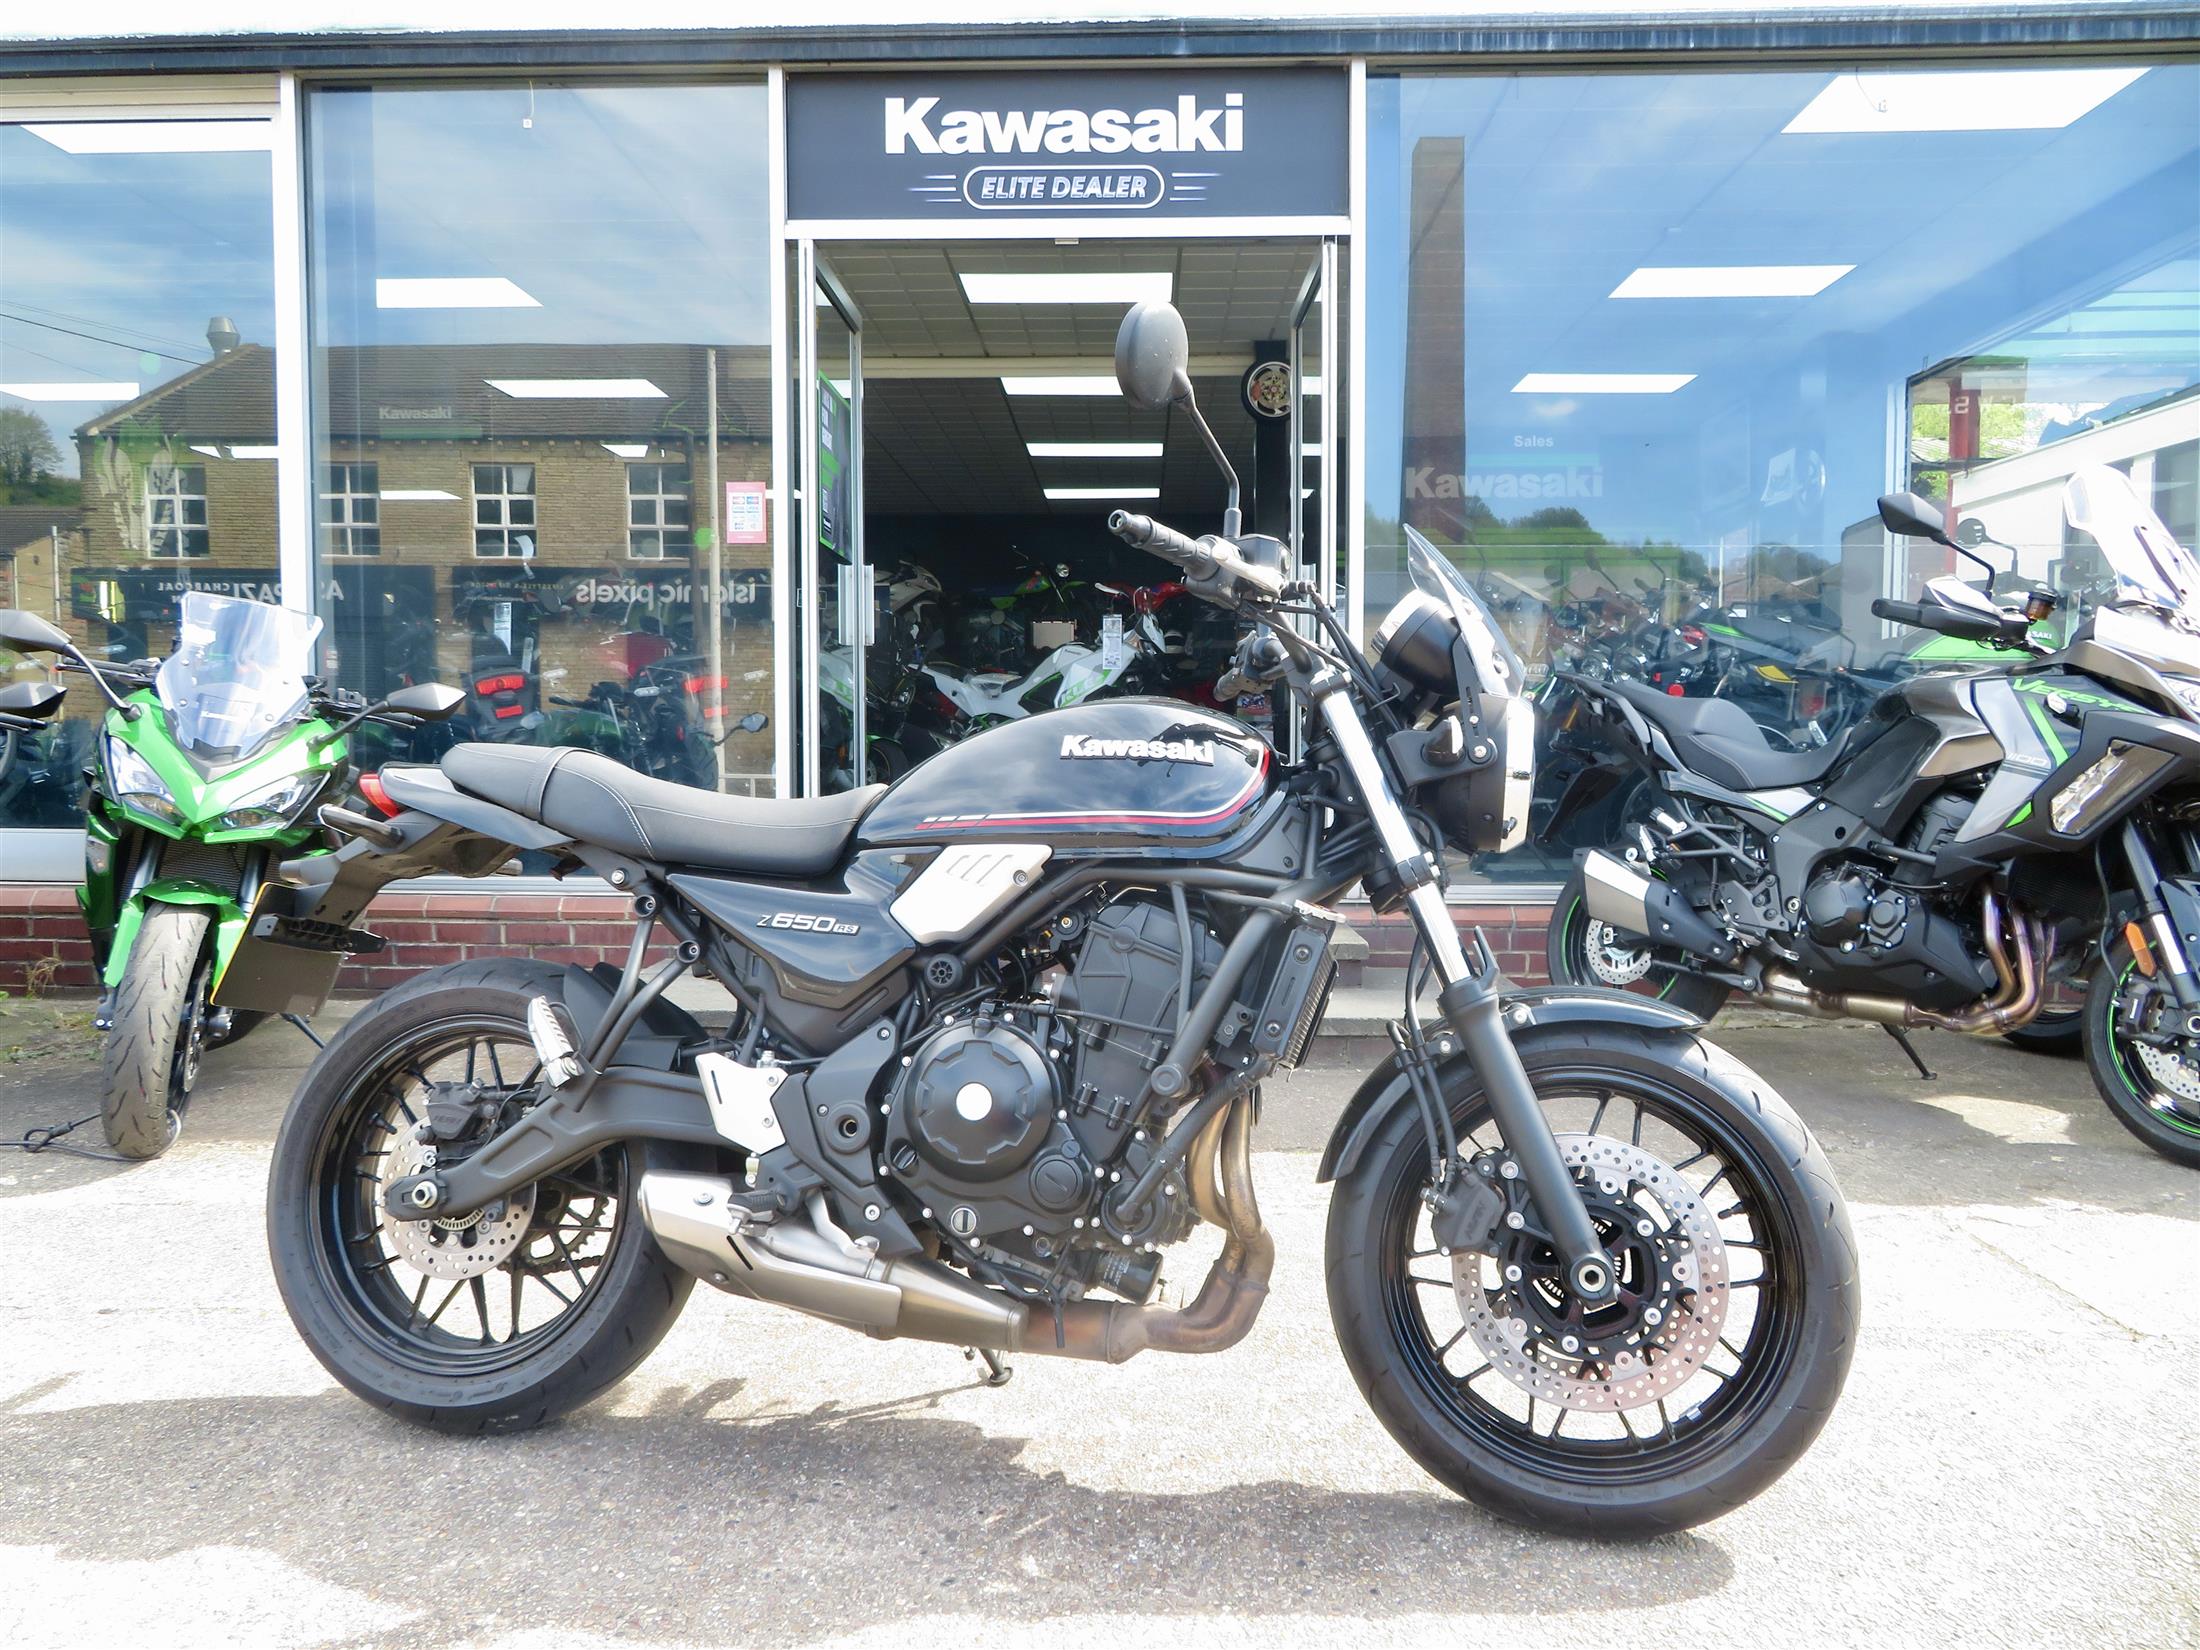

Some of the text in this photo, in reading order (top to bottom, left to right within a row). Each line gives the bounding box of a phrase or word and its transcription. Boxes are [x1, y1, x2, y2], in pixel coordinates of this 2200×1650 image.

[885, 93, 1244, 154] Kawasaki
[981, 175, 1148, 199] ELITE DEALER
[378, 405, 452, 419] Kawasaki
[1514, 435, 1554, 448] Sales
[1405, 465, 1604, 499] Kawasaki
[1060, 734, 1215, 766] Kawasaki
